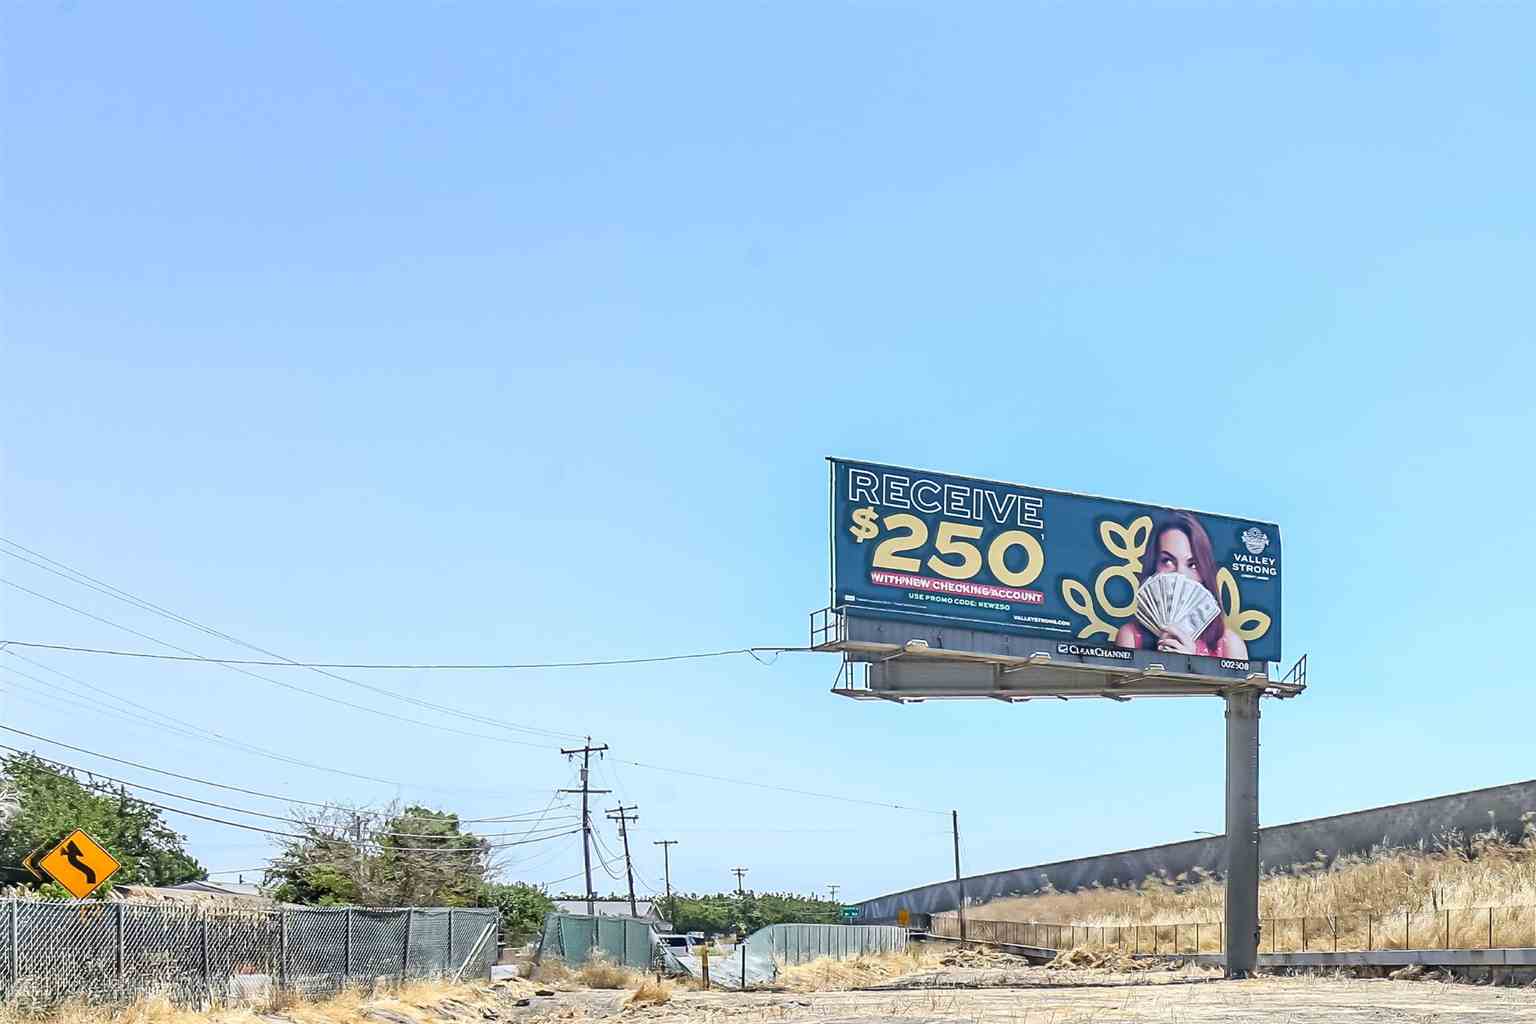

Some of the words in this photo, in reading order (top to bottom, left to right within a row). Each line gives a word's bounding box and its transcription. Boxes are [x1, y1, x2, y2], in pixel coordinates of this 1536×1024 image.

[848, 468, 1044, 529] RECEIVE
[849, 505, 1045, 587] $250
[1232, 562, 1277, 576] STRONG
[1233, 553, 1276, 566] VALLEY
[871, 571, 901, 585] WITH
[901, 575, 930, 589] NEW
[932, 581, 991, 596] CHECKING
[991, 588, 1042, 602] ACCOUNT
[908, 592, 924, 601] USE
[925, 595, 953, 604] PROMO
